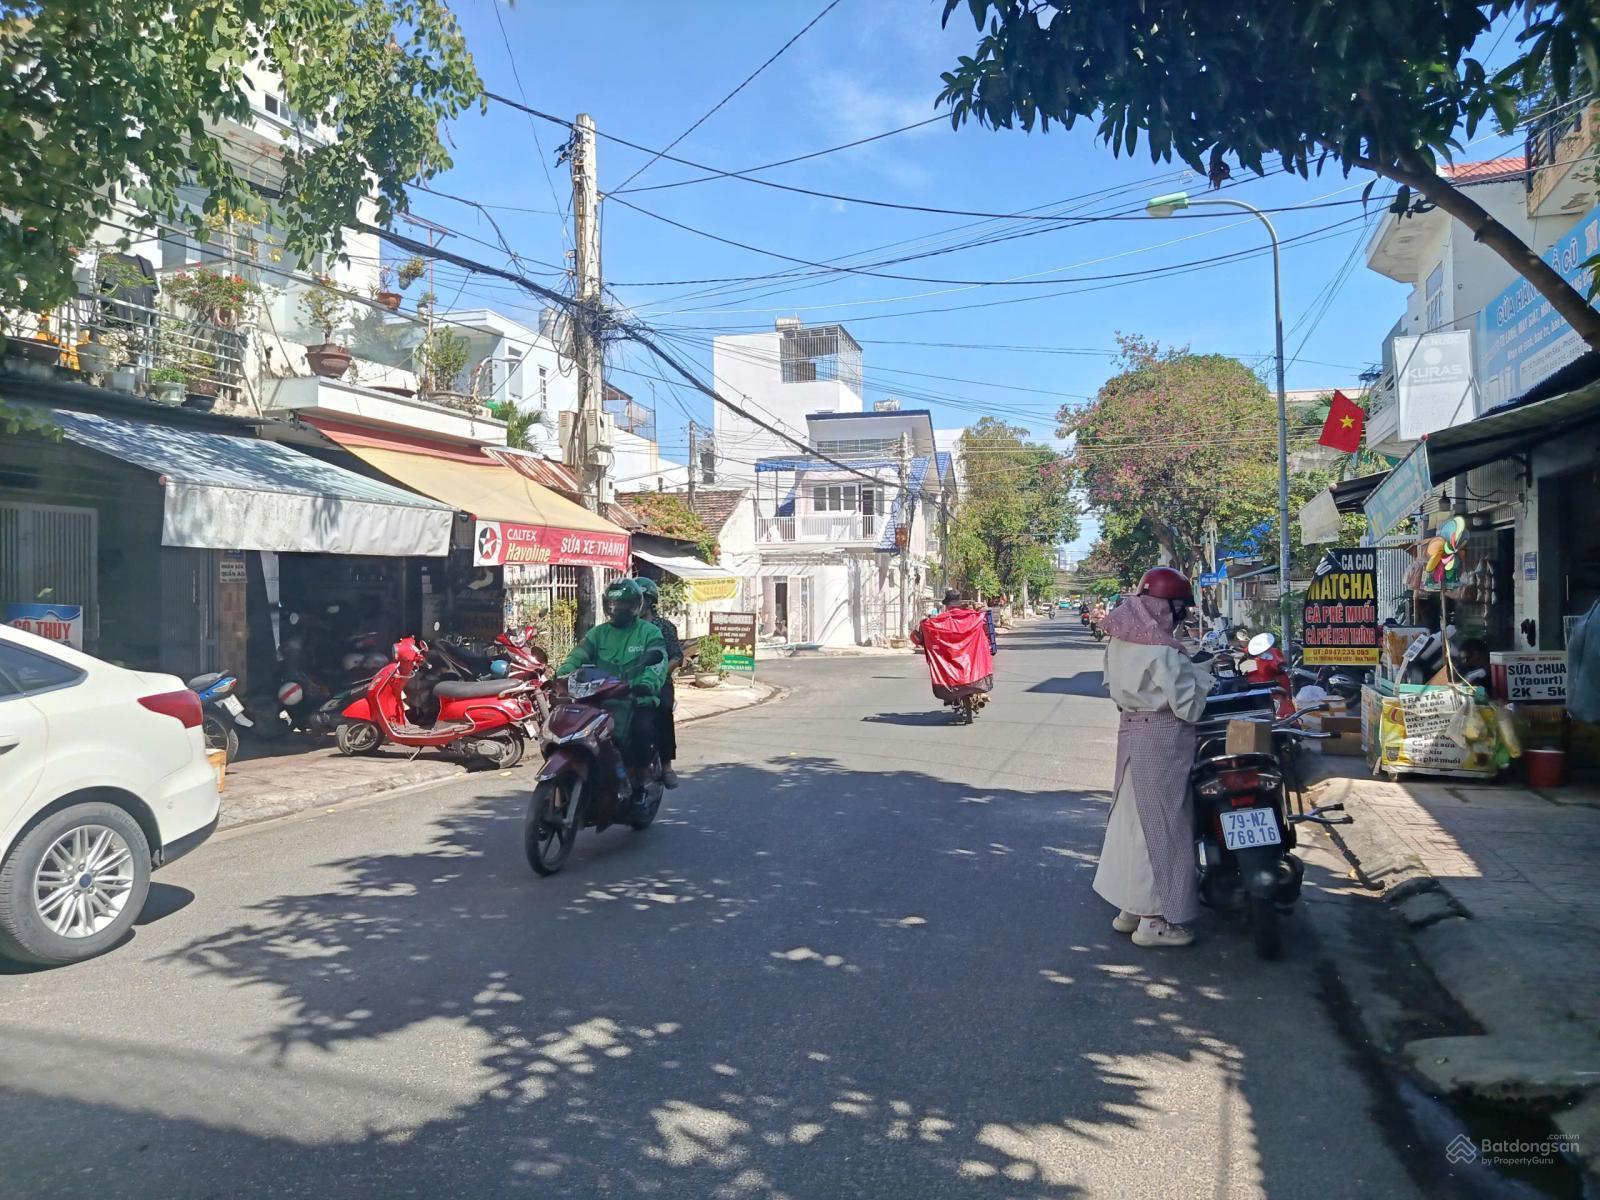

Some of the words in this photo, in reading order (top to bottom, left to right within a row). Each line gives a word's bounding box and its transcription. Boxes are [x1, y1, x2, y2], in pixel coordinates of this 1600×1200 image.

[1409, 364, 1463, 378] KURAS
[507, 528, 537, 541] CALTEX
[505, 543, 551, 563] Havoline
[561, 534, 581, 554] SỬA
[583, 539, 598, 555] XE
[1342, 554, 1354, 571] CA
[1355, 554, 1374, 570] CAO
[1305, 602, 1321, 623] CÀ
[1322, 602, 1344, 623] PHÊ
[1345, 600, 1375, 623] MUỐI
[1508, 662, 1532, 675] SỮA
[1535, 663, 1567, 675] CHUA
[1514, 675, 1563, 686] (Yaourt)
[1512, 687, 1531, 697] 2K
[1228, 812, 1267, 830] 79-N2
[1228, 827, 1276, 847] 768.16
